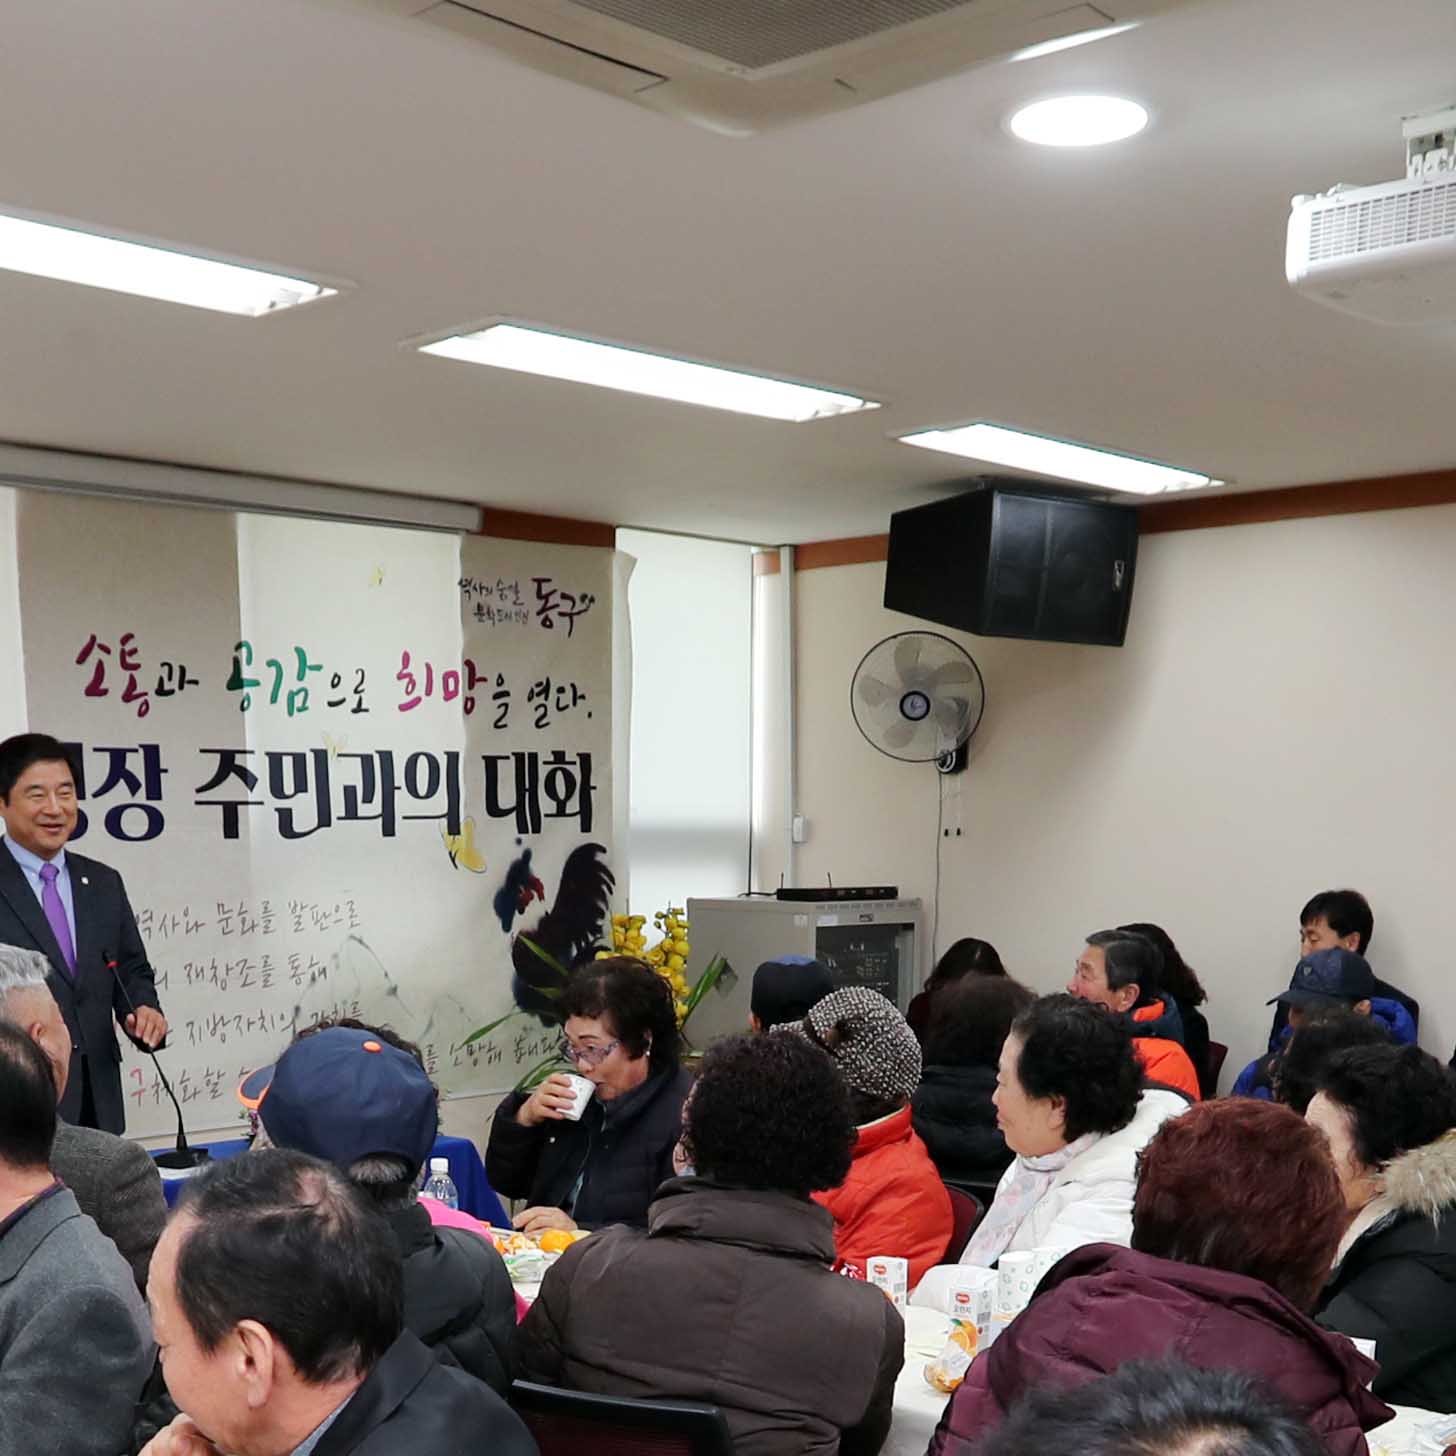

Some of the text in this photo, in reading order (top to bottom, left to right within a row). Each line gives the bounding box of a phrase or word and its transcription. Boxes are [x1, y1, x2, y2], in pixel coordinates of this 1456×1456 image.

[531, 576, 592, 638] 동구
[75, 632, 594, 729] 소통과 공감으로 희망을 열다.
[194, 746, 464, 840] 주민과의
[481, 750, 597, 834] 대화
[216, 900, 276, 936] 문화를
